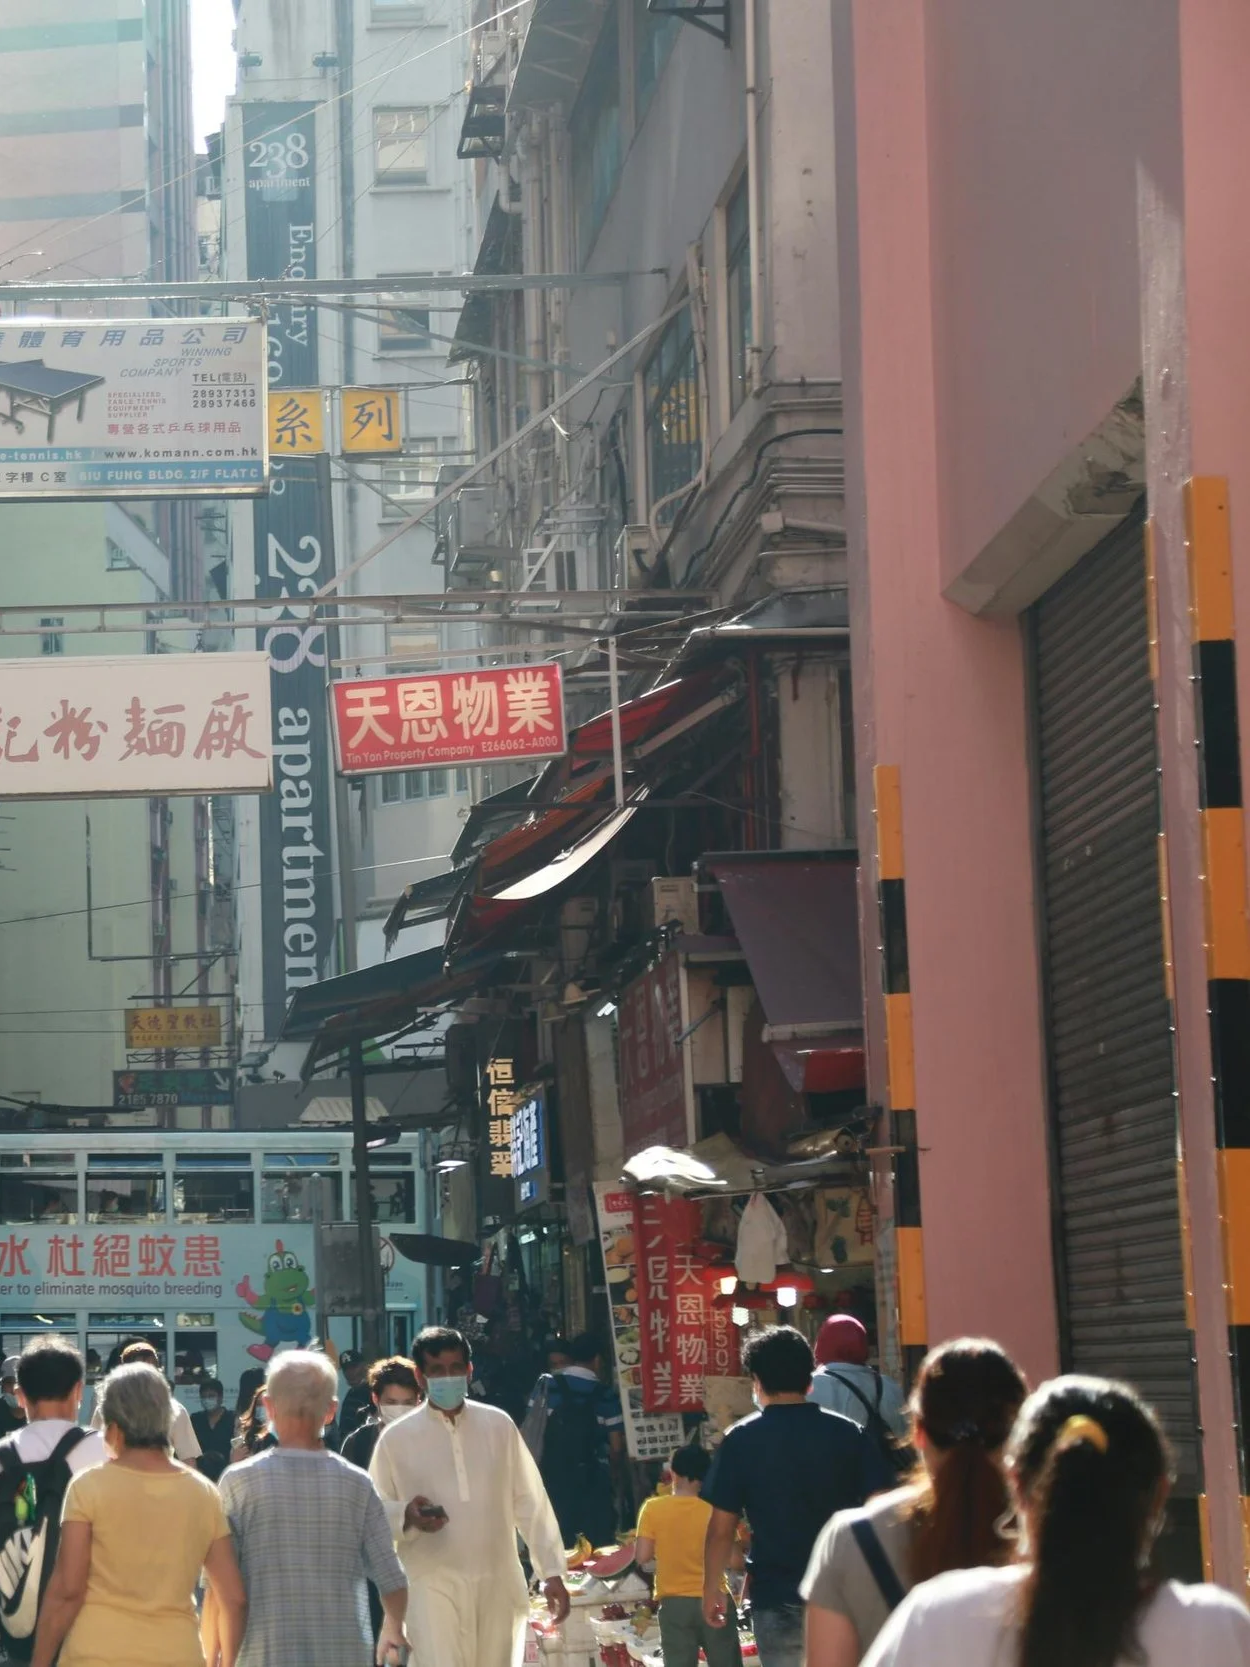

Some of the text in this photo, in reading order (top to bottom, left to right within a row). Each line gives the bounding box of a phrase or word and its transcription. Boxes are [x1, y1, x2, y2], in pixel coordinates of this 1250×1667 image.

[249, 133, 309, 179] 238
[248, 177, 311, 191] apartment
[286, 223, 315, 346] Enqiry
[181, 347, 233, 357] WINNING
[154, 357, 202, 368] SPORTS
[120, 368, 183, 378] COMPANY
[107, 391, 162, 399] SPECIALIZED
[193, 389, 256, 398] 28937313
[193, 399, 256, 409] 28937466
[107, 422, 242, 435] 專營各式乒乓球用品
[104, 447, 258, 459] www.komann.com.hk
[107, 470, 142, 480] FUNG
[189, 468, 210, 479] 2/F
[215, 468, 247, 478] FLAT
[345, 671, 554, 749] 天恩物業
[347, 752, 361, 763] Tin
[384, 747, 426, 761] Property
[427, 745, 475, 757] Company
[272, 707, 325, 1009] apartmen
[46, 1233, 222, 1278] 杜絕蚊患
[17, 1283, 31, 1296] to
[34, 1282, 95, 1296] eliminate
[99, 1282, 161, 1299] mosquito
[164, 1281, 223, 1299] breeding
[674, 1254, 708, 1405] 天恩物業
